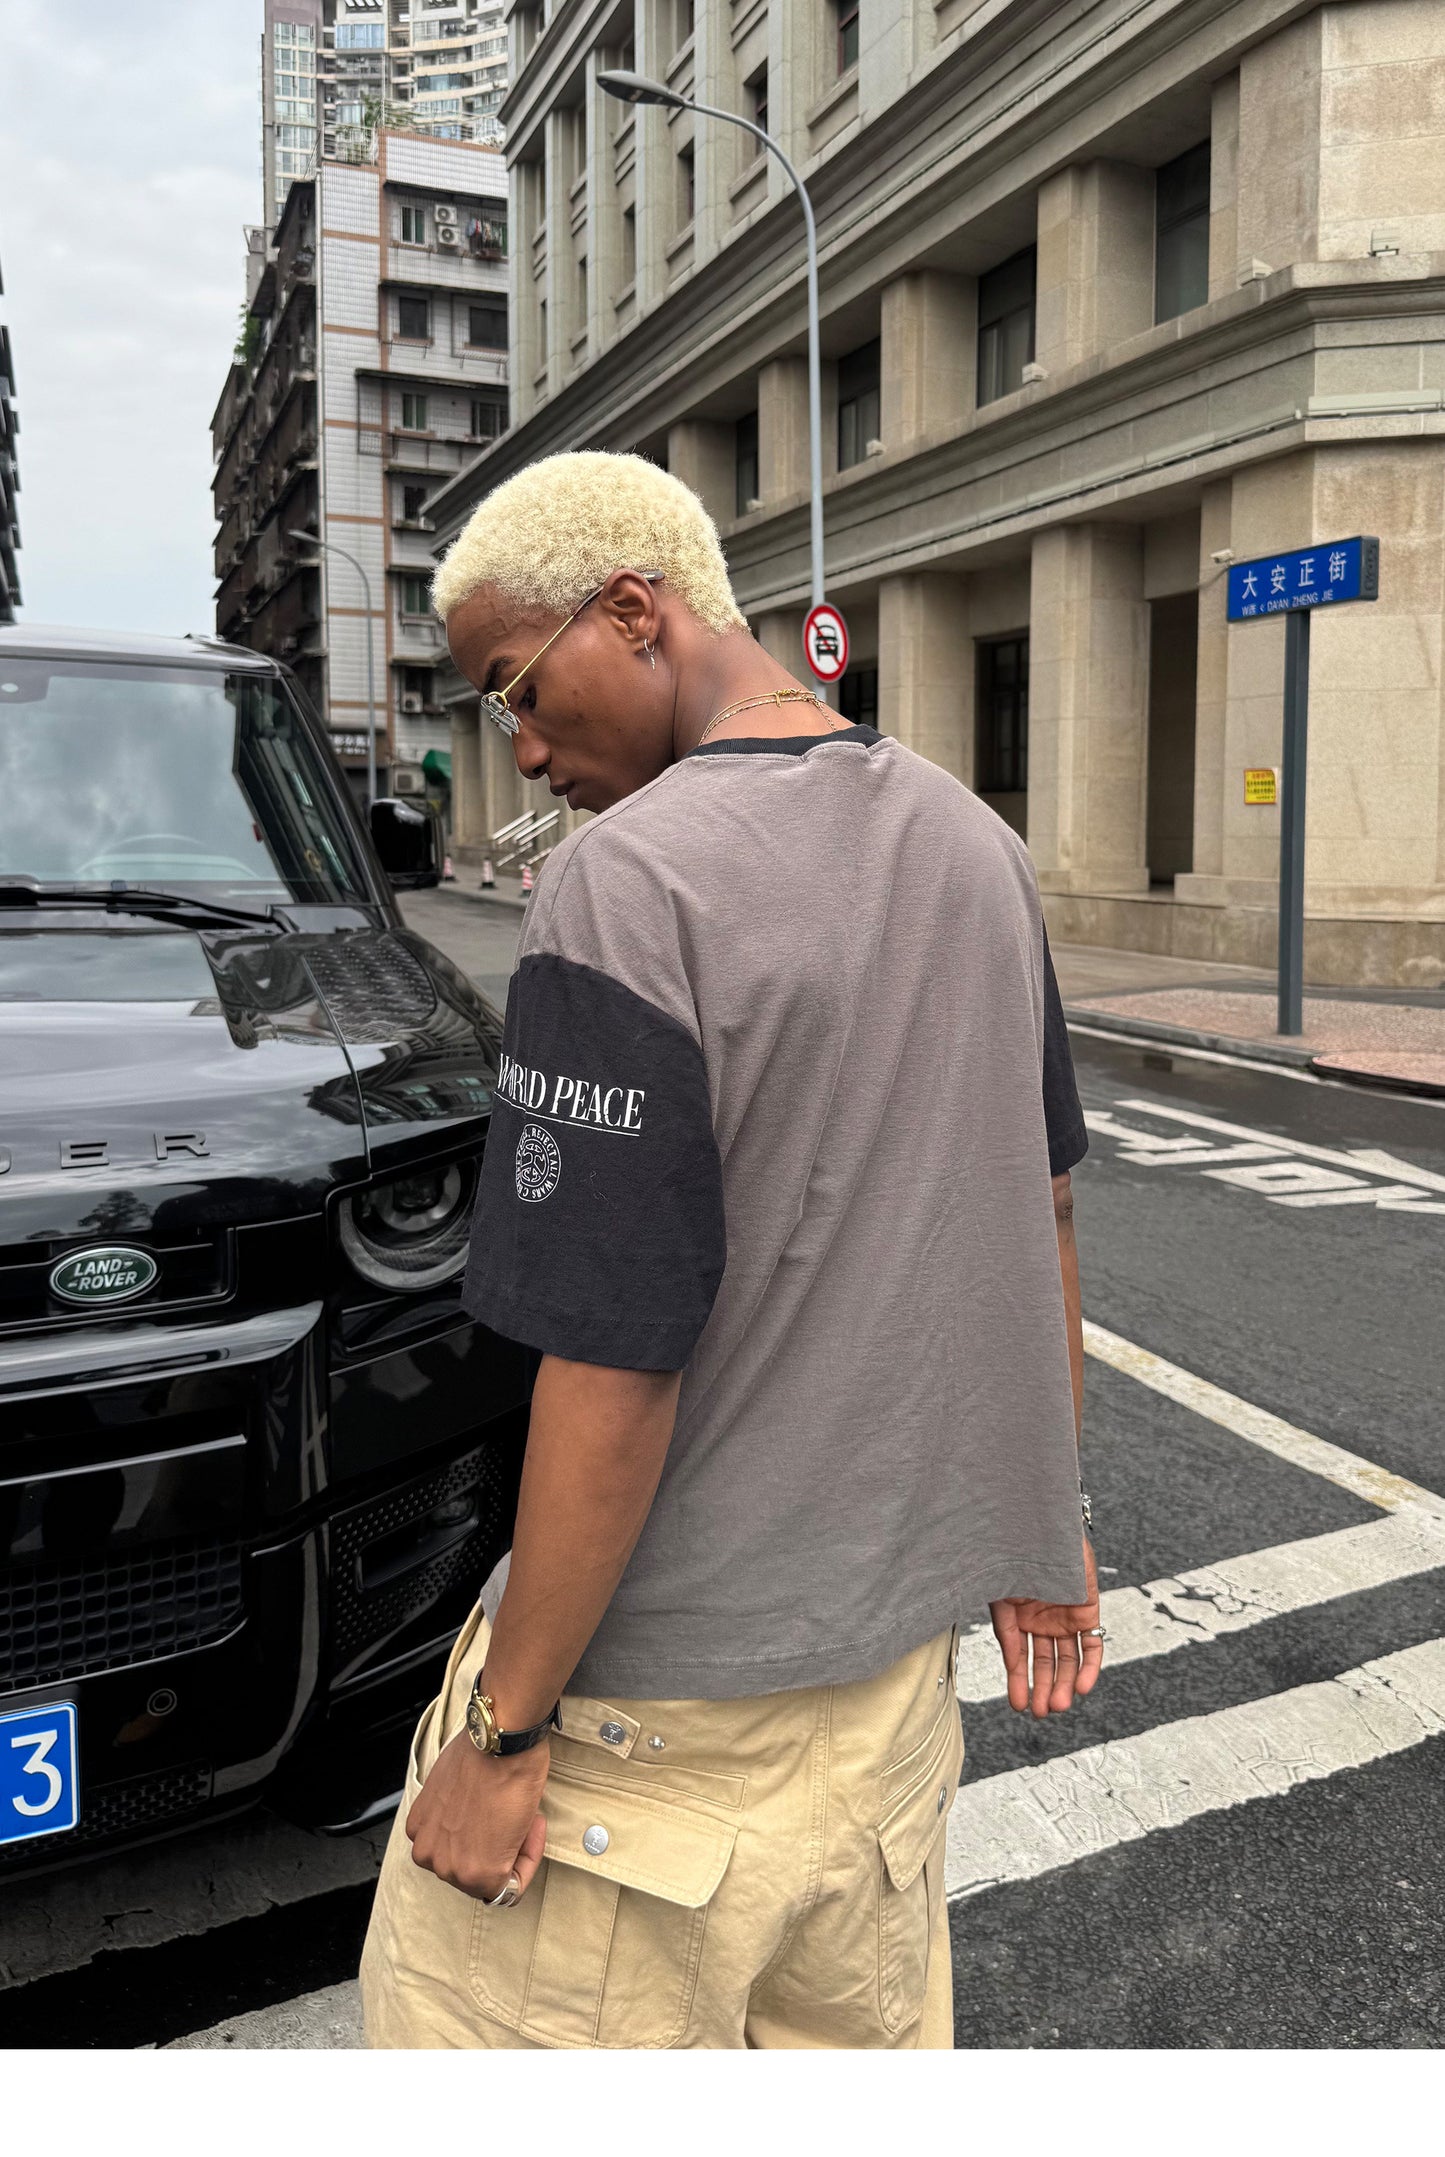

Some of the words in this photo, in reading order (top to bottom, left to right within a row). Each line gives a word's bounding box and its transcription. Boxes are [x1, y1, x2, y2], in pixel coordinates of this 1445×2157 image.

[1241, 552, 1347, 599] 大安正街
[1292, 592, 1319, 608] ZHENG
[1322, 588, 1334, 602] JIE
[550, 1075, 645, 1130] PEACE
[0, 1129, 210, 1175] ER
[531, 1127, 558, 1157] REJECT
[548, 1159, 558, 1178] ALL
[531, 1180, 554, 1199] WARS
[74, 1258, 122, 1277] LAND
[78, 1270, 138, 1291] ROVER
[11, 1729, 63, 1817] 3
